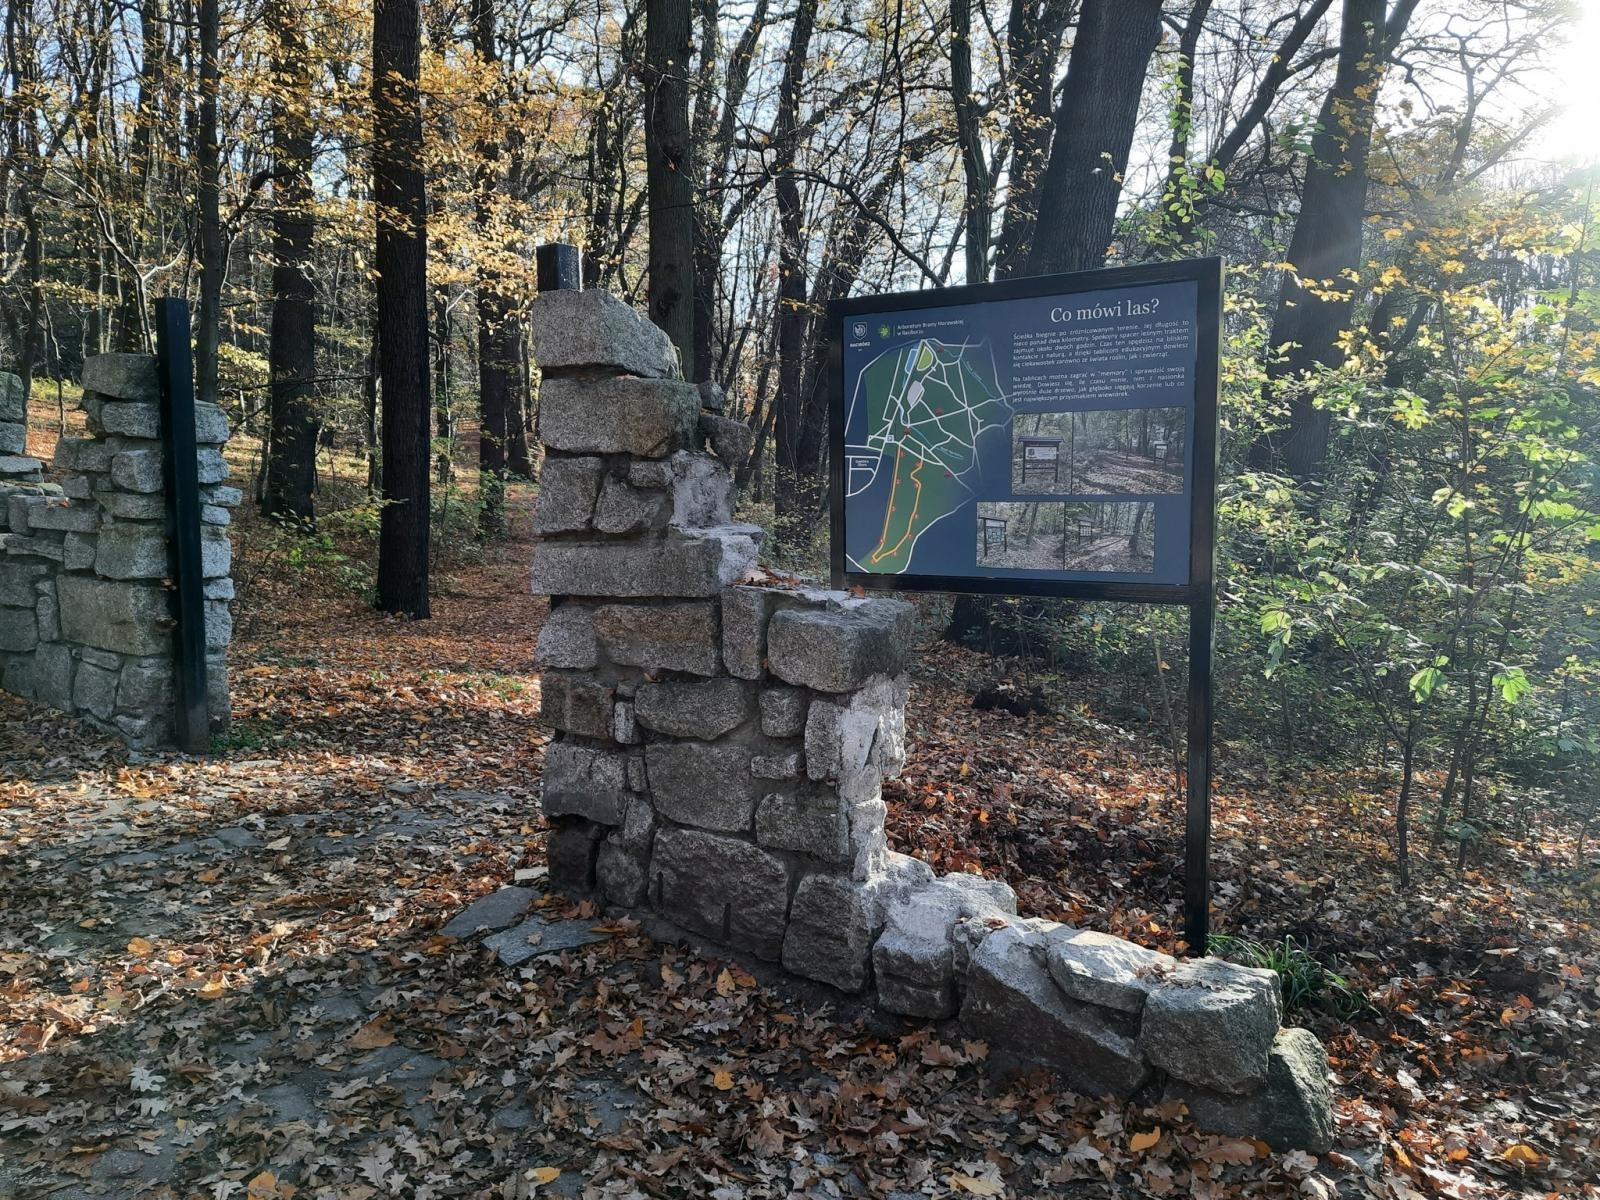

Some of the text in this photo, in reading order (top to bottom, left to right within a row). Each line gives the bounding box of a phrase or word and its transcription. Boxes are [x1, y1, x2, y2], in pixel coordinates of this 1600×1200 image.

[1051, 298, 1160, 322] Co mówi las?
